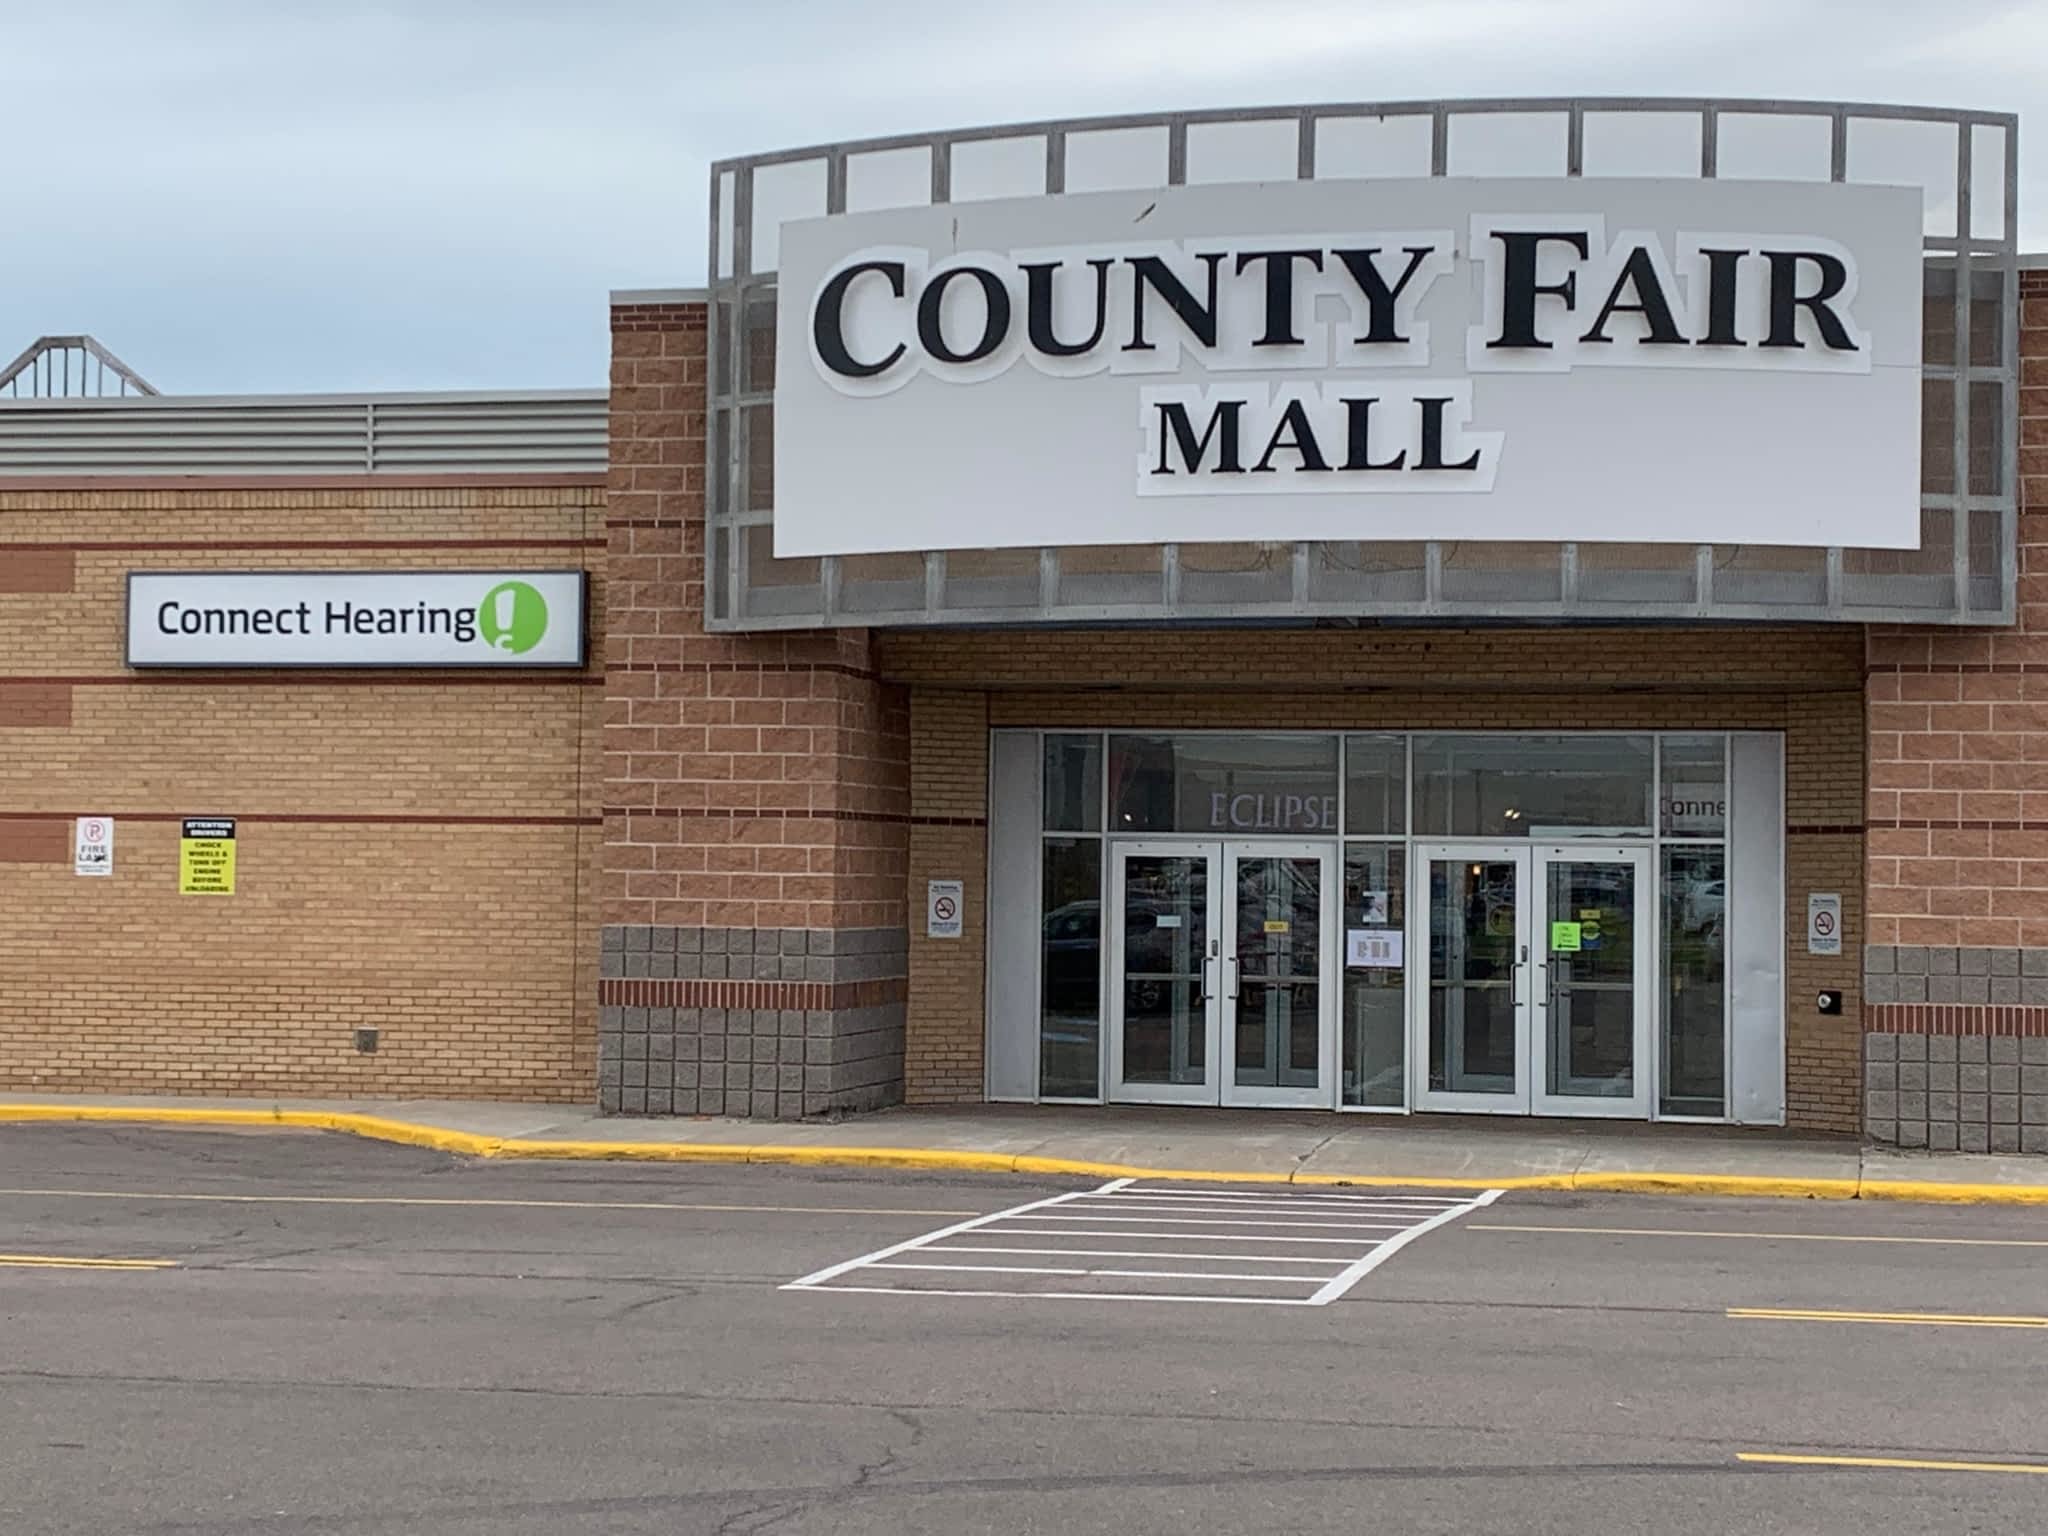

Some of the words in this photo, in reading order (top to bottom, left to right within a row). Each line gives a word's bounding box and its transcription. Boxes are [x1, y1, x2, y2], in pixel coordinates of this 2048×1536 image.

[813, 246, 1435, 378] COUNTY
[1485, 231, 1860, 351] FAIR
[1151, 397, 1481, 475] MALL
[158, 601, 311, 635] Connect
[325, 601, 476, 643] Hearing
[1209, 792, 1337, 830] ECLIPSE
[80, 845, 106, 854] FIRE
